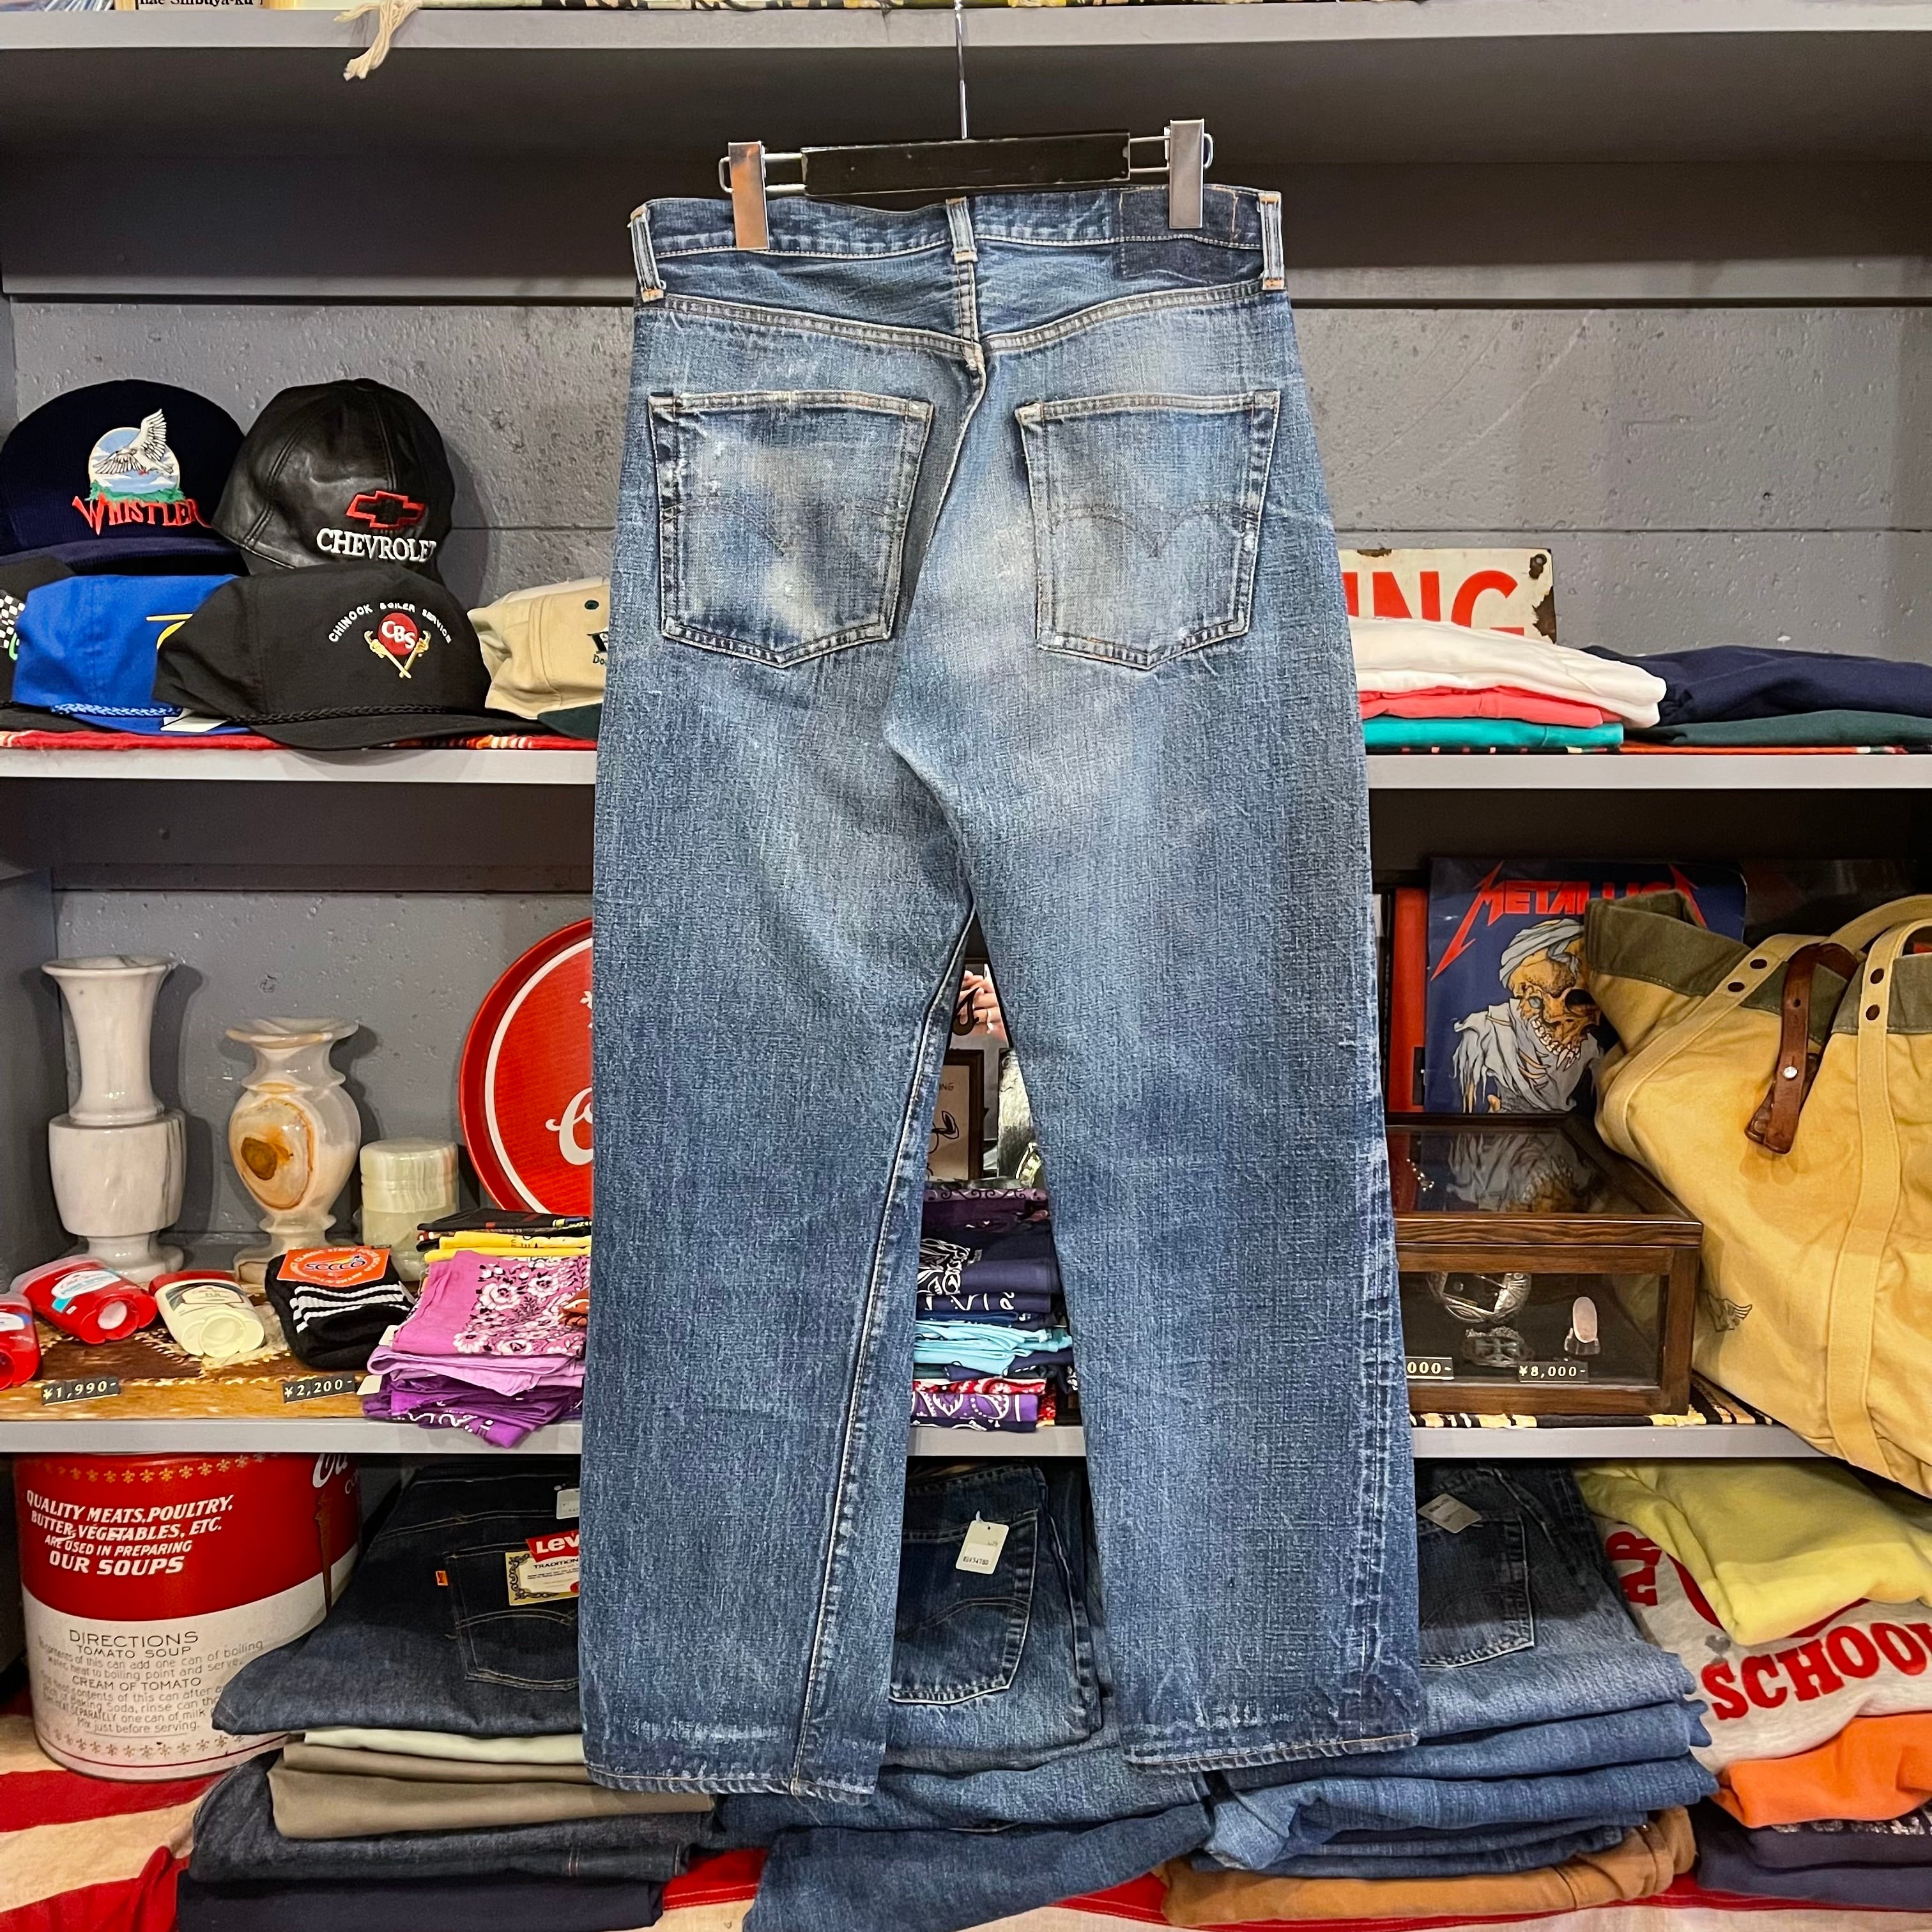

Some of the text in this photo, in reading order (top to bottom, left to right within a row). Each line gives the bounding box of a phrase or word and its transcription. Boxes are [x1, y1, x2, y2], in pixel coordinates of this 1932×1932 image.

[72, 493, 207, 536] WHISTLER
[328, 604, 373, 643] CHINOOK
[381, 620, 416, 650] CBS
[1430, 860, 1708, 982] METALA
[1519, 1365, 1586, 1379] ¥8,000-
[43, 1381, 117, 1400] ¥1,990-
[284, 1379, 353, 1398] ¥2,200-
[27, 1489, 86, 1521] QUALITY
[188, 1516, 222, 1536] ETC.
[44, 1535, 193, 1557] ARE USED IN PREPARING
[49, 1551, 185, 1576] OUR SOUPS
[69, 1629, 199, 1648] DIRECTIONS
[75, 1655, 83, 1664] of
[86, 1657, 103, 1668] this
[107, 1660, 126, 1669] can
[130, 1660, 150, 1669] add
[155, 1659, 176, 1669] one
[181, 1656, 203, 1666] can
[207, 1650, 220, 1661] of
[224, 1640, 264, 1659] boiling
[76, 1644, 191, 1659] TOMATO SOUP
[72, 1675, 114, 1690] CREAM
[119, 1682, 137, 1691] OF
[141, 1677, 201, 1691] TOMATO
[93, 1669, 102, 1678] to
[104, 1670, 141, 1682] boiling
[146, 1669, 175, 1680] point
[180, 1665, 203, 1677] and
[72, 1687, 114, 1702] contents
[118, 1694, 128, 1703] of
[134, 1693, 155, 1703] this
[159, 1693, 179, 1701] can
[183, 1687, 212, 1699] after
[106, 1702, 138, 1713] Soda,
[141, 1704, 172, 1713] rinse
[177, 1700, 198, 1710] can
[121, 1714, 142, 1723] one
[144, 1715, 165, 1723] can
[168, 1711, 179, 1721] of
[183, 1708, 206, 1720] milk
[94, 1721, 114, 1733] just
[116, 1722, 151, 1733] before
